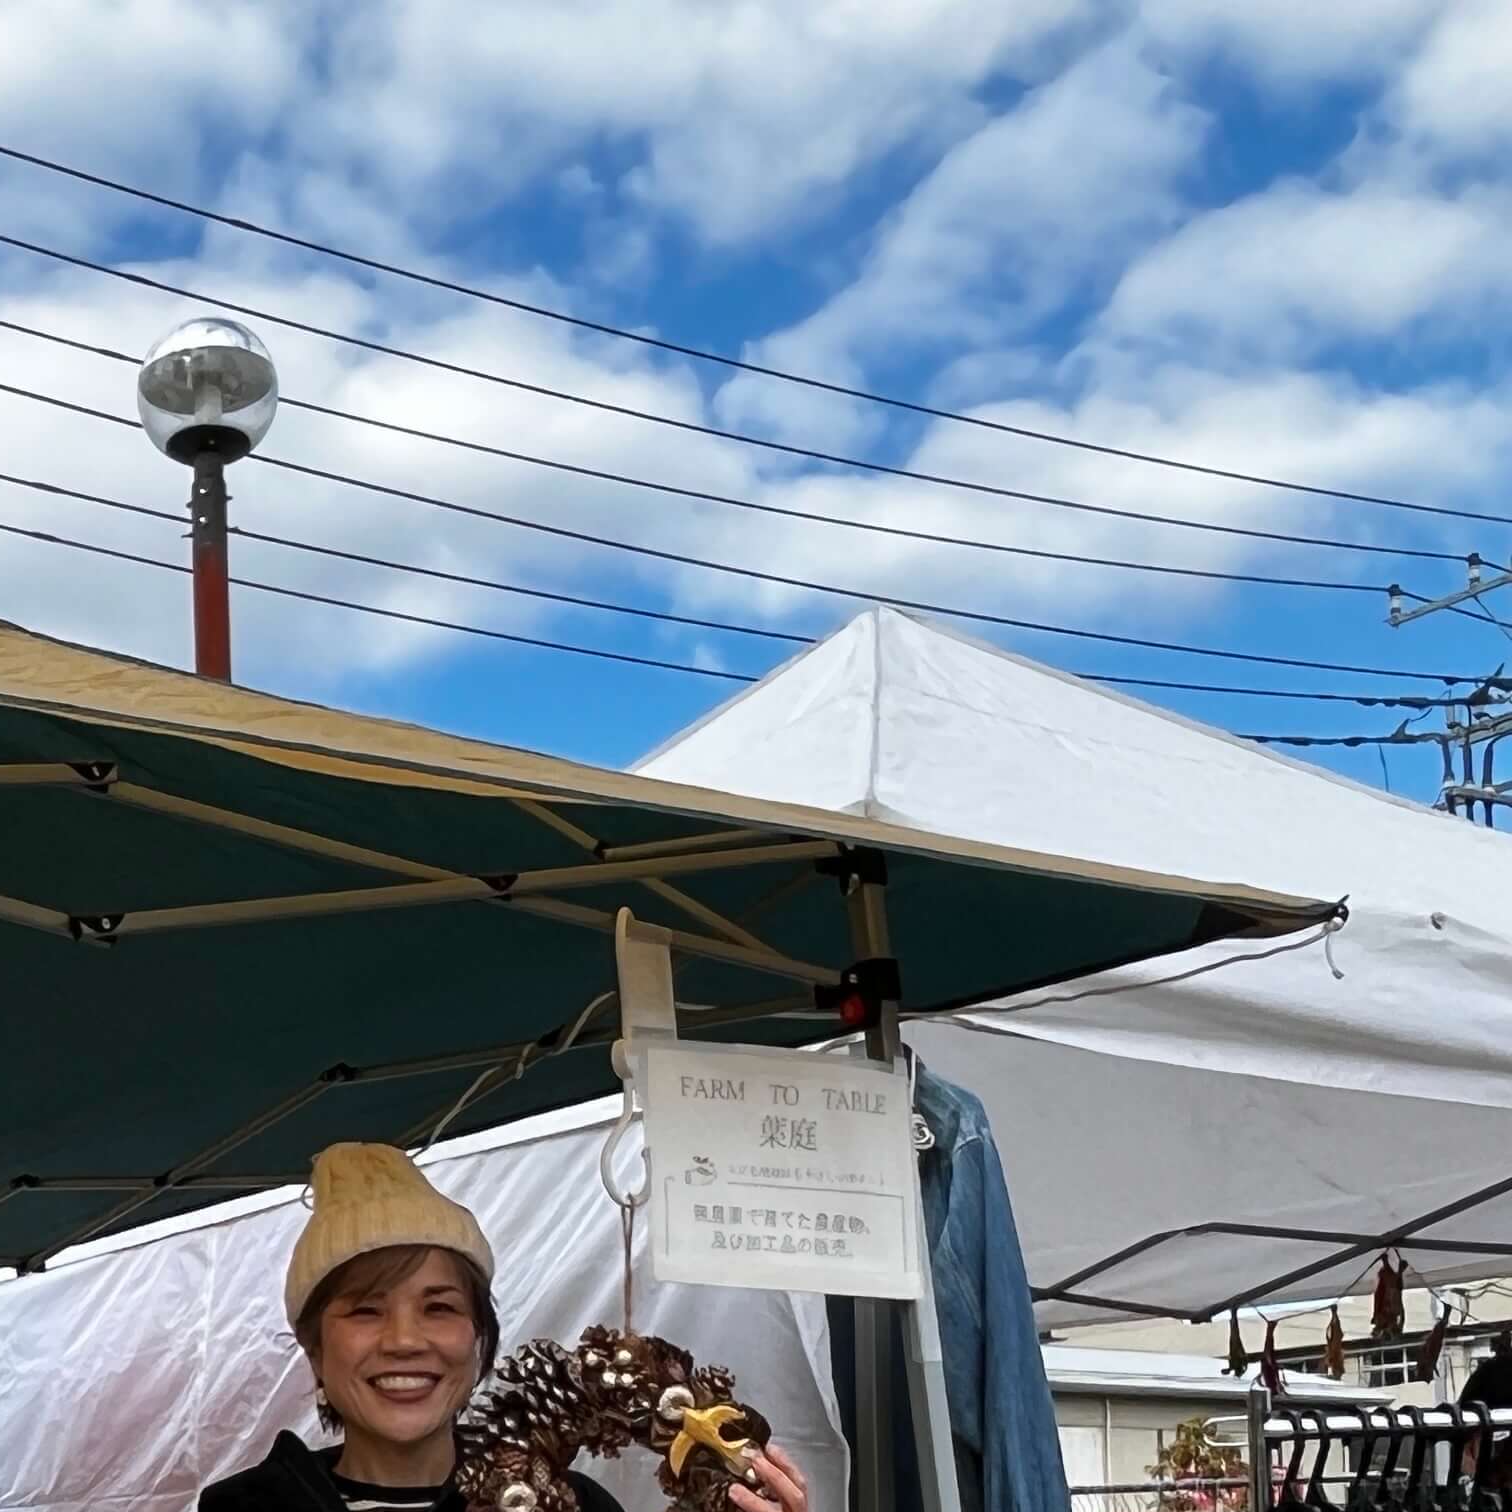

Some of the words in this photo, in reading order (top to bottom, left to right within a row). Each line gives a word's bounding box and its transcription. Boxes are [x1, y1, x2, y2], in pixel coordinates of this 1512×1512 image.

[680, 1076, 745, 1101] FARM
[769, 1084, 800, 1106] TO
[821, 1087, 887, 1115] TABLE
